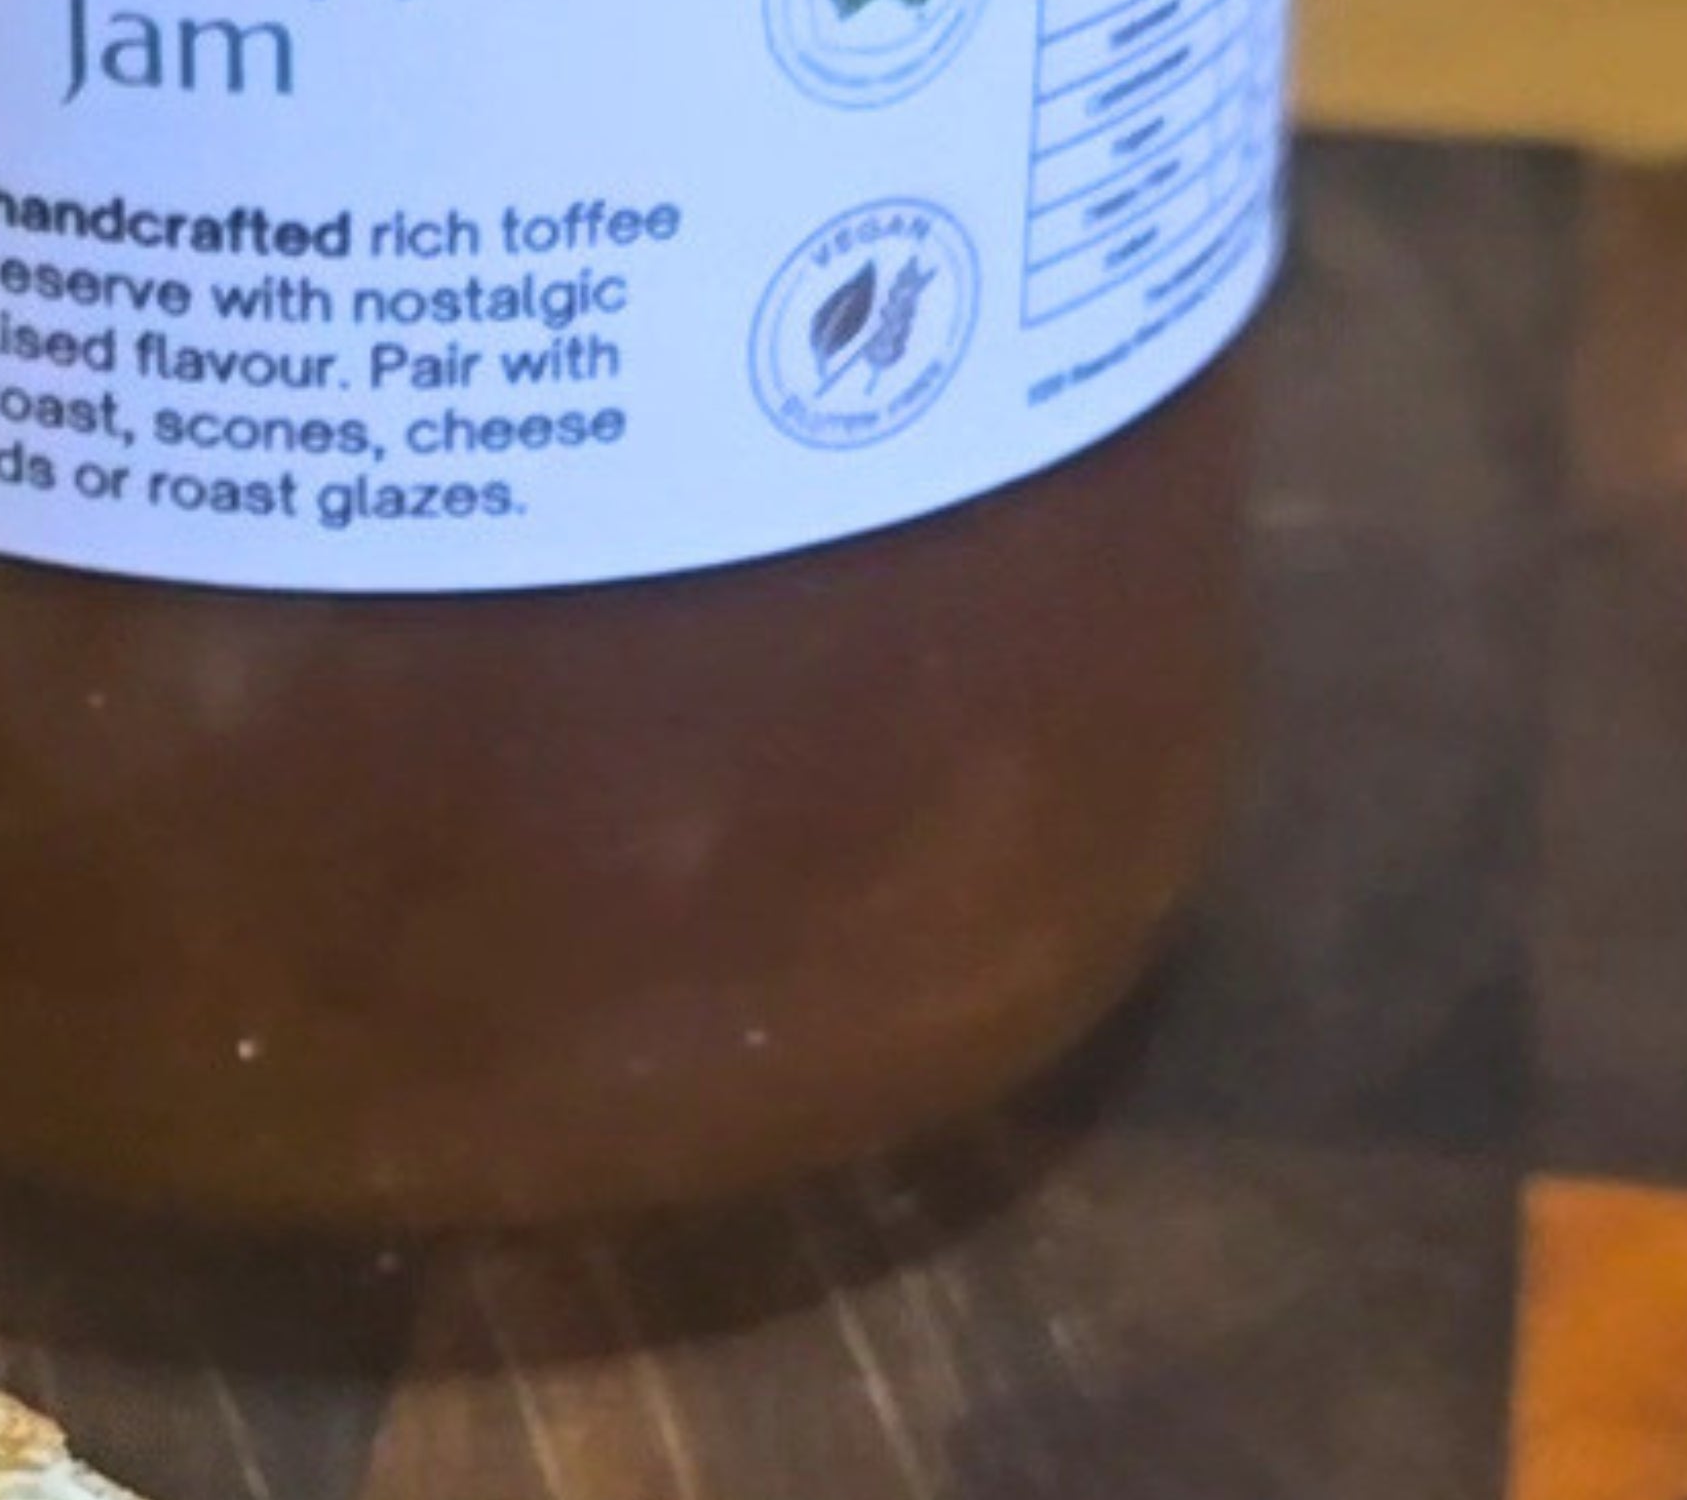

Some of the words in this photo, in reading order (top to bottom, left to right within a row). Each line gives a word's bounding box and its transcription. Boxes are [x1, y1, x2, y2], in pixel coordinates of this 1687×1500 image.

[370, 209, 481, 258] rich
[501, 199, 682, 255] toffee
[811, 212, 932, 268] VEGAN
[212, 275, 333, 324] with
[352, 266, 628, 331] nostalgic
[136, 330, 351, 390] flavour.
[369, 341, 483, 389] Pair
[500, 333, 620, 384] with
[154, 407, 386, 463] scones,
[406, 406, 627, 454] cheese
[74, 461, 129, 499] or
[147, 471, 297, 517] roast
[316, 473, 527, 531] glazes.
